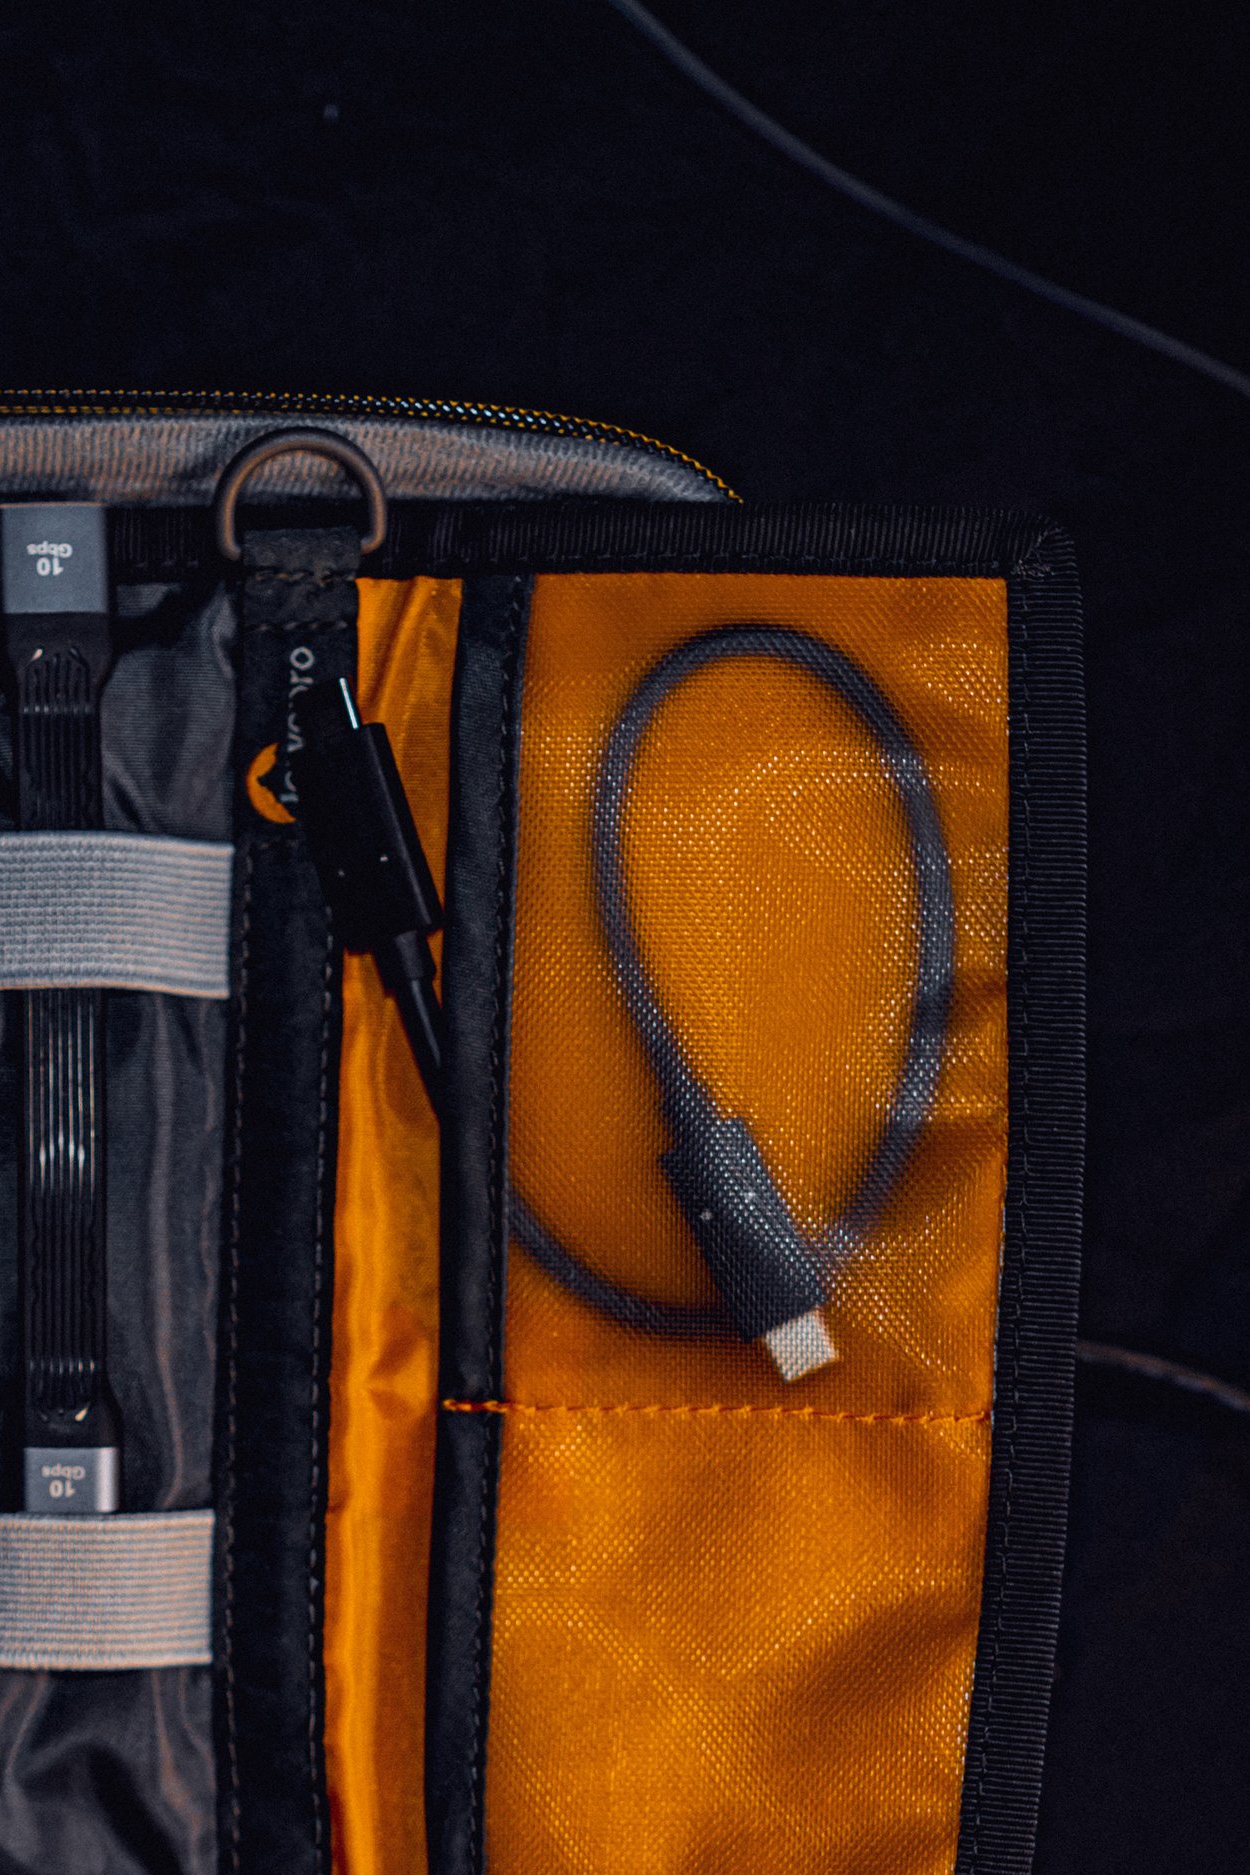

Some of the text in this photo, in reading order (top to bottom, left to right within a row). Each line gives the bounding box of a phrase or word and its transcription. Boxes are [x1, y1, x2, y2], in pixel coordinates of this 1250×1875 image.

[26, 541, 73, 558] Gbps
[36, 557, 64, 576] 10
[41, 1463, 86, 1481] Gbps
[49, 1479, 76, 1499] 10
